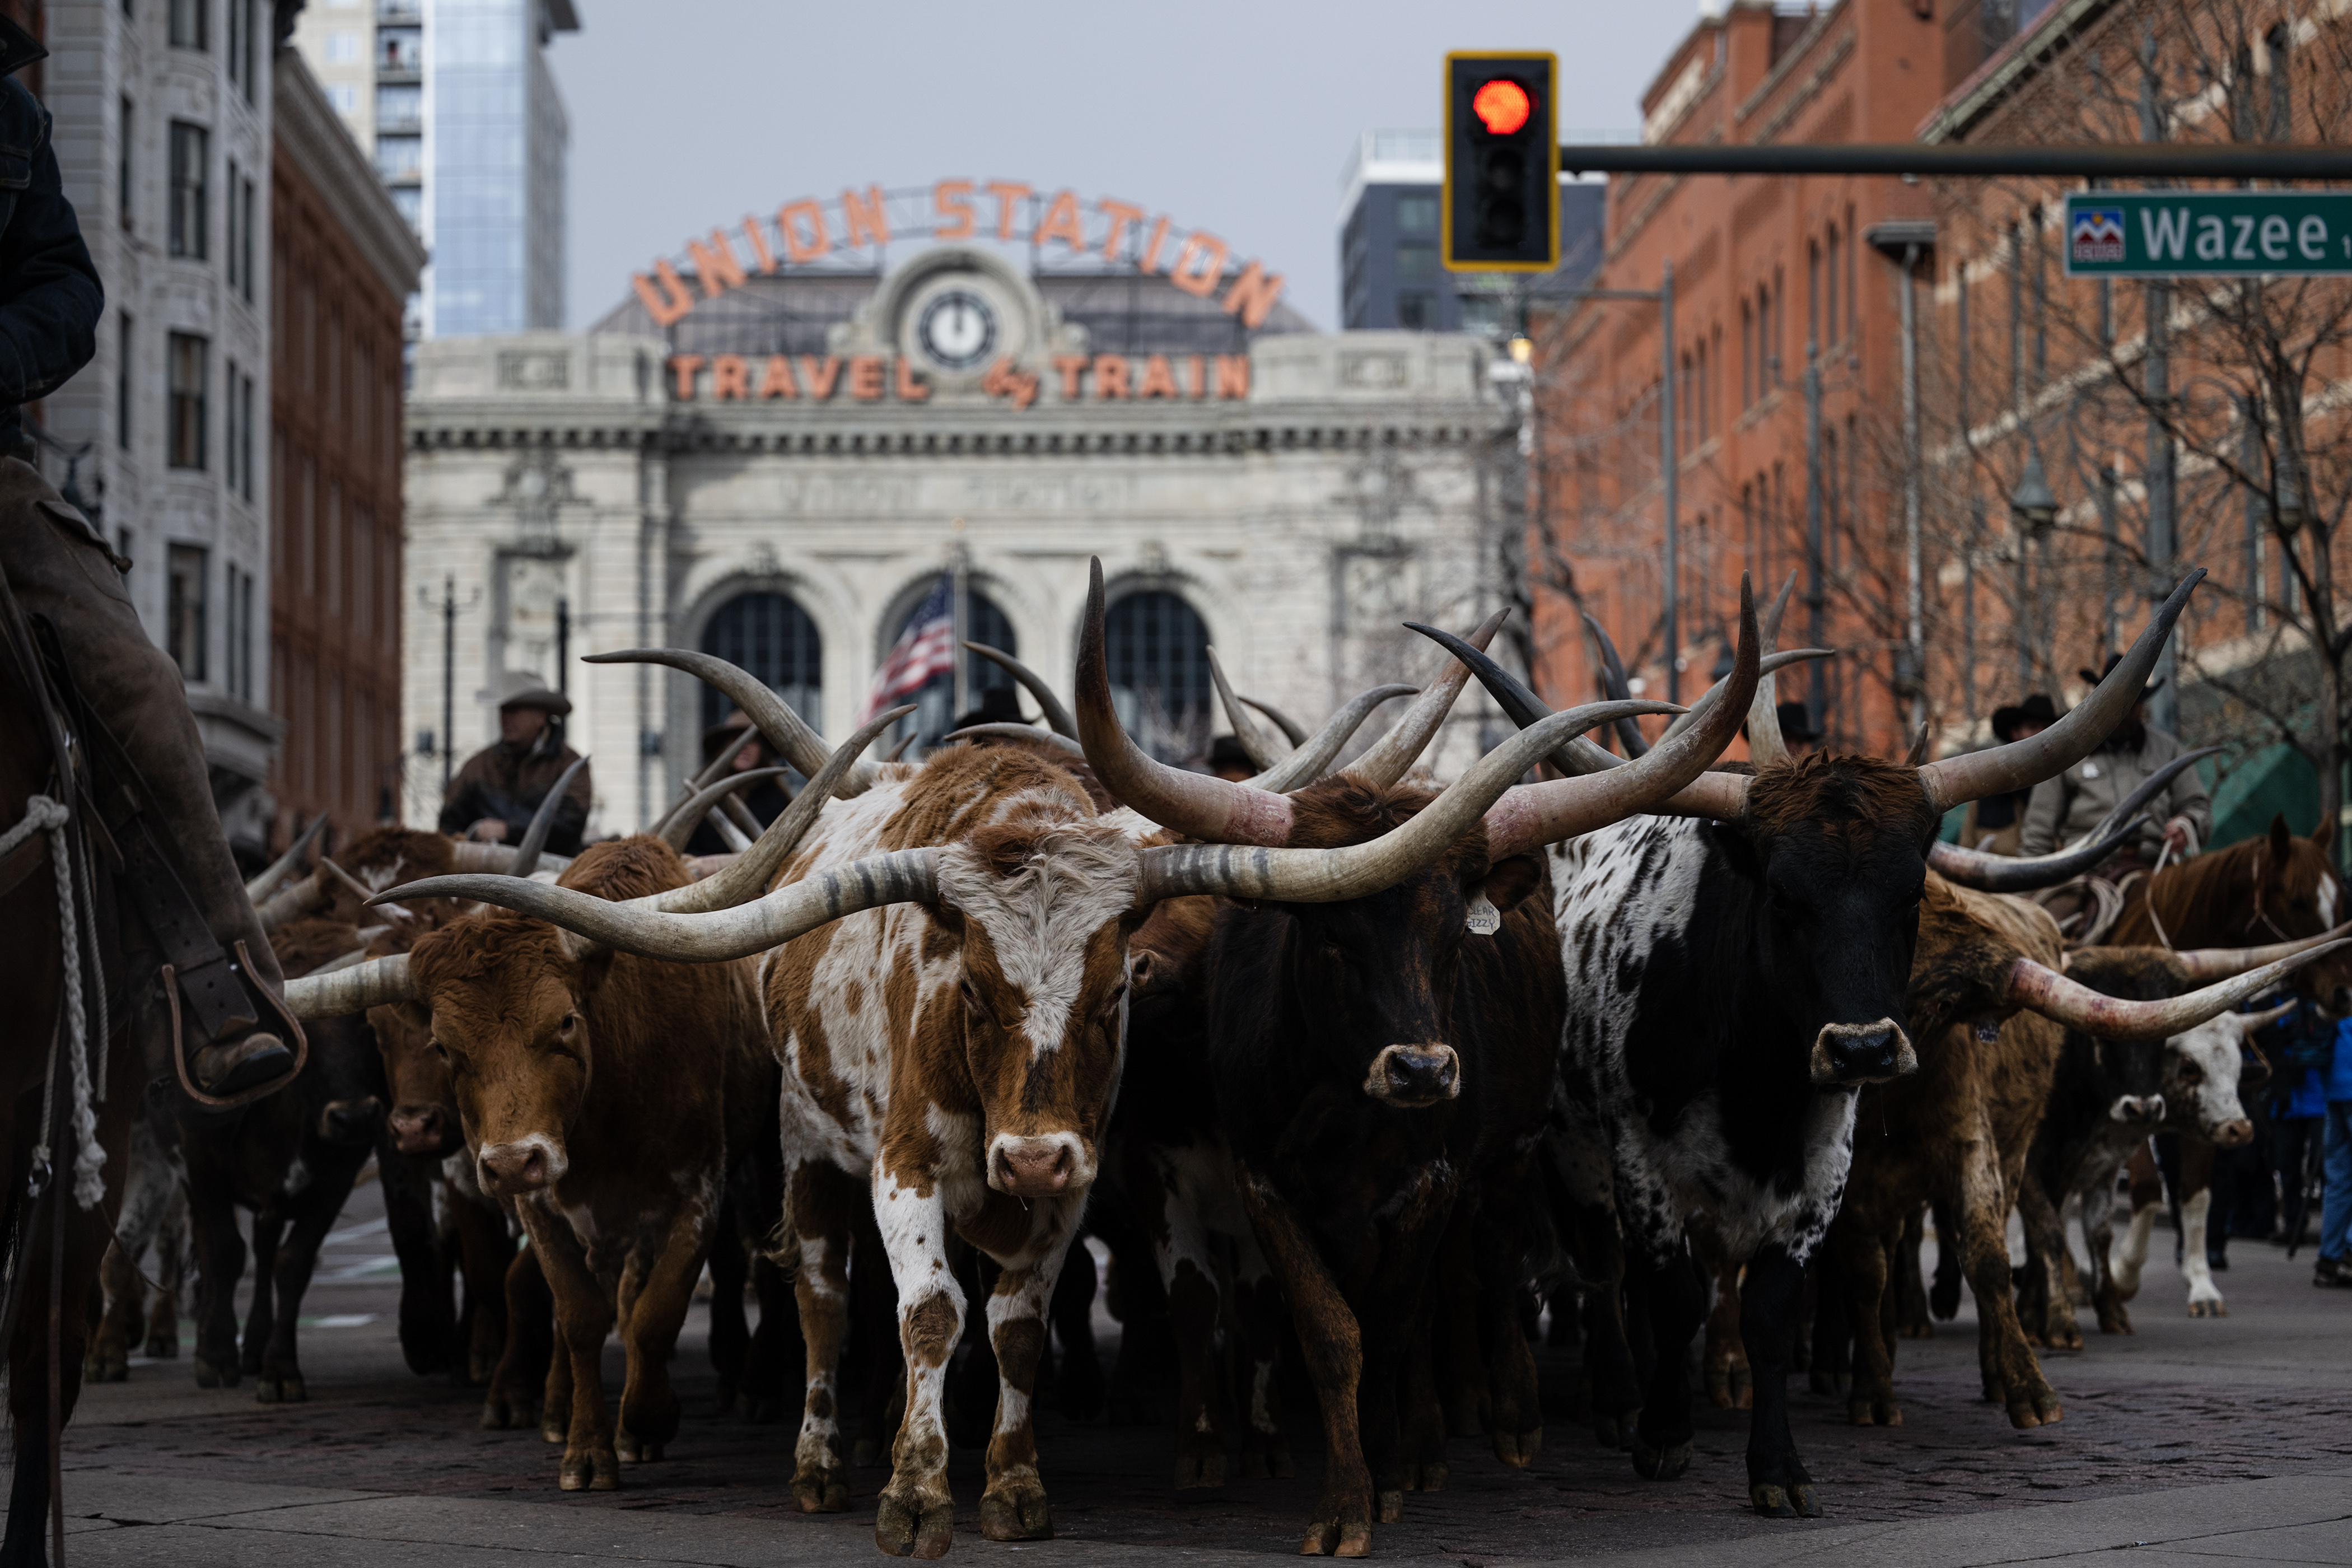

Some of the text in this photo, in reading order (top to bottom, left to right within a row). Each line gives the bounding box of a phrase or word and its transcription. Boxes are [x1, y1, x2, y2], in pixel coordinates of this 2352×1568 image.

[633, 182, 1282, 328] UNION STATION
[2139, 207, 2328, 260] Wazee
[670, 354, 1250, 411] TRAVEL by TRAIN
